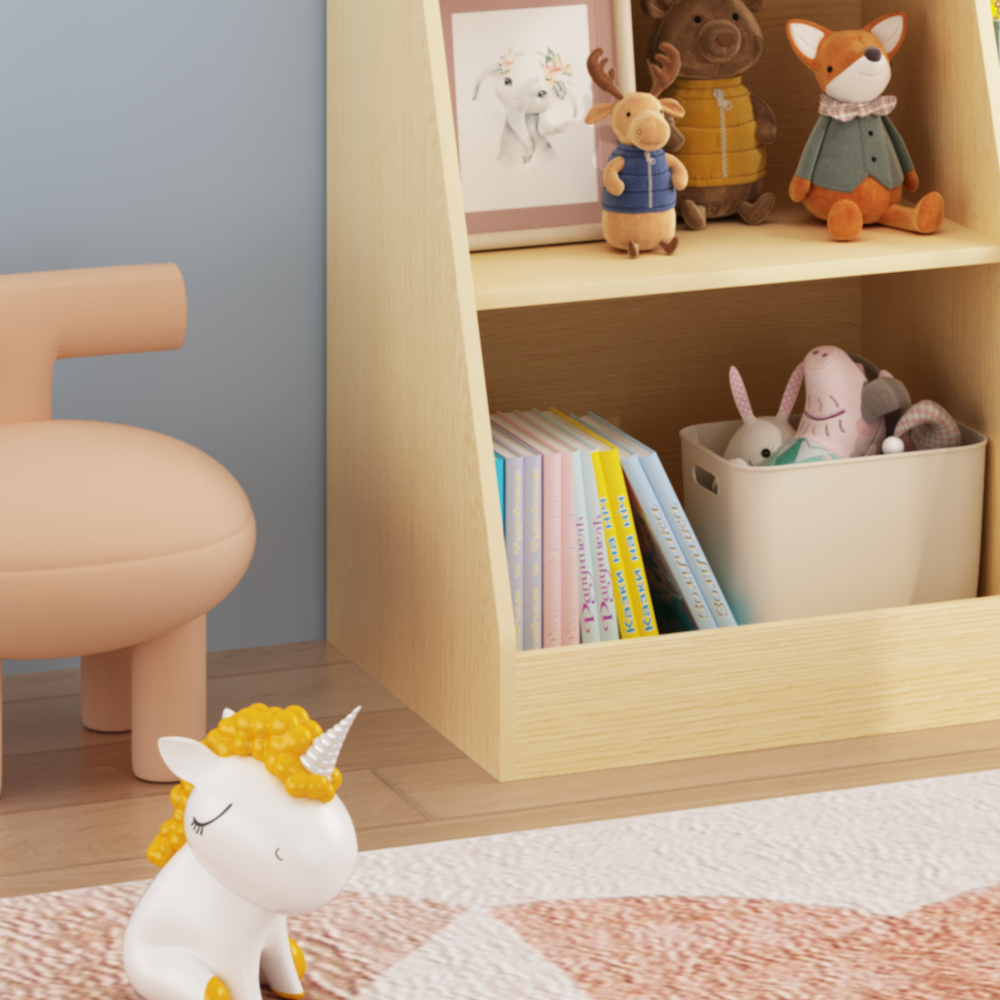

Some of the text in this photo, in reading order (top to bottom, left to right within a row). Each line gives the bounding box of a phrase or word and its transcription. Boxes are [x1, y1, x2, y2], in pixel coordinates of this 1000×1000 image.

[608, 537, 620, 564] на
[617, 495, 655, 632] Казки на ніч
[615, 570, 636, 634] Казки
